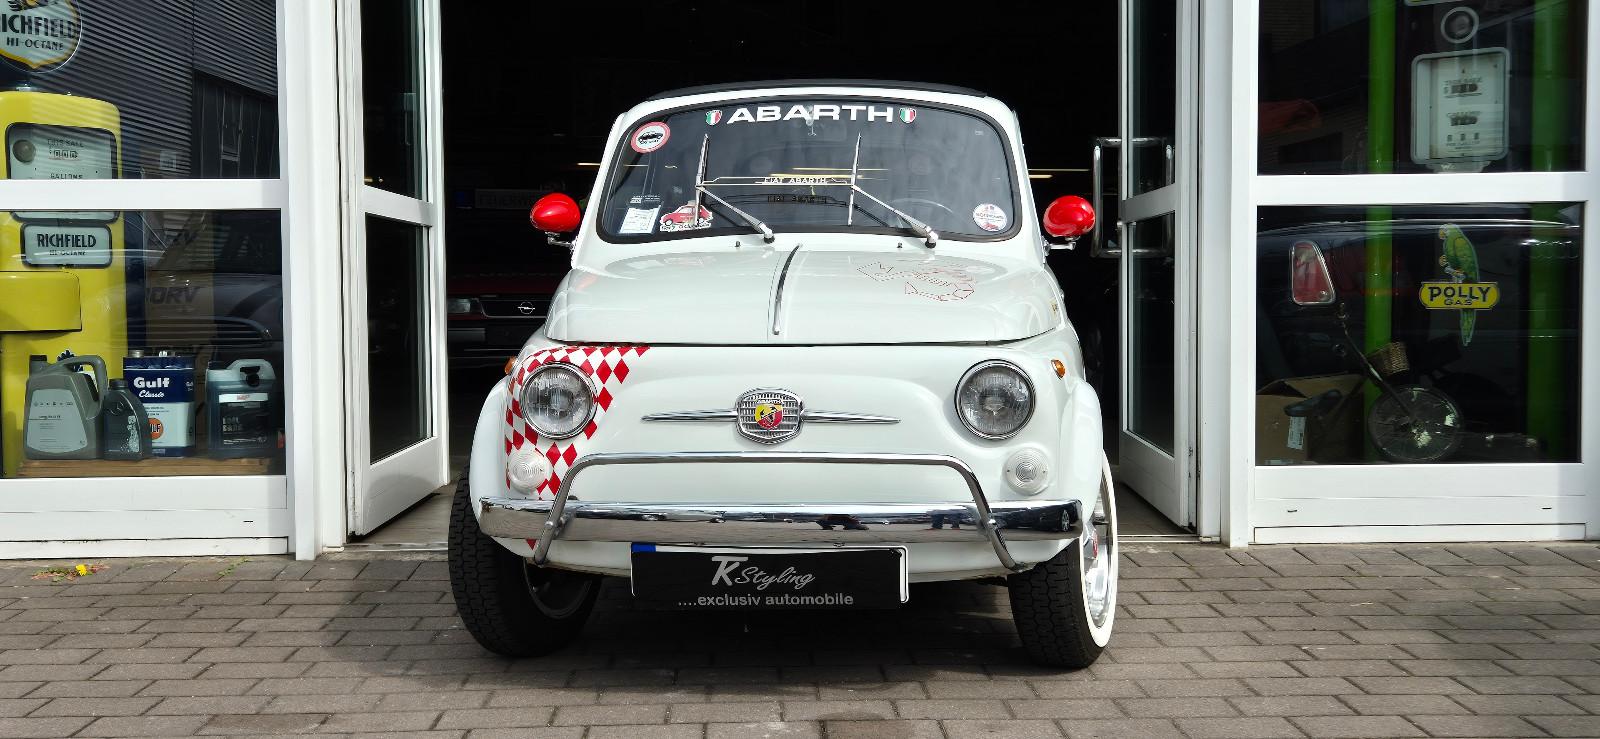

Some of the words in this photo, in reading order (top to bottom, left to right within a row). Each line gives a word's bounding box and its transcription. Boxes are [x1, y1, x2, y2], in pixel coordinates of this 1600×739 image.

[0, 13, 76, 39] ICHFIELD
[6, 36, 64, 51] HI-OCTANE
[727, 104, 894, 124] ABARTH
[36, 233, 97, 248] RICHFIELD
[1428, 285, 1491, 302] POLLY
[133, 376, 170, 389] Gulf
[138, 389, 165, 398] Classic
[765, 592, 854, 606] automobile
